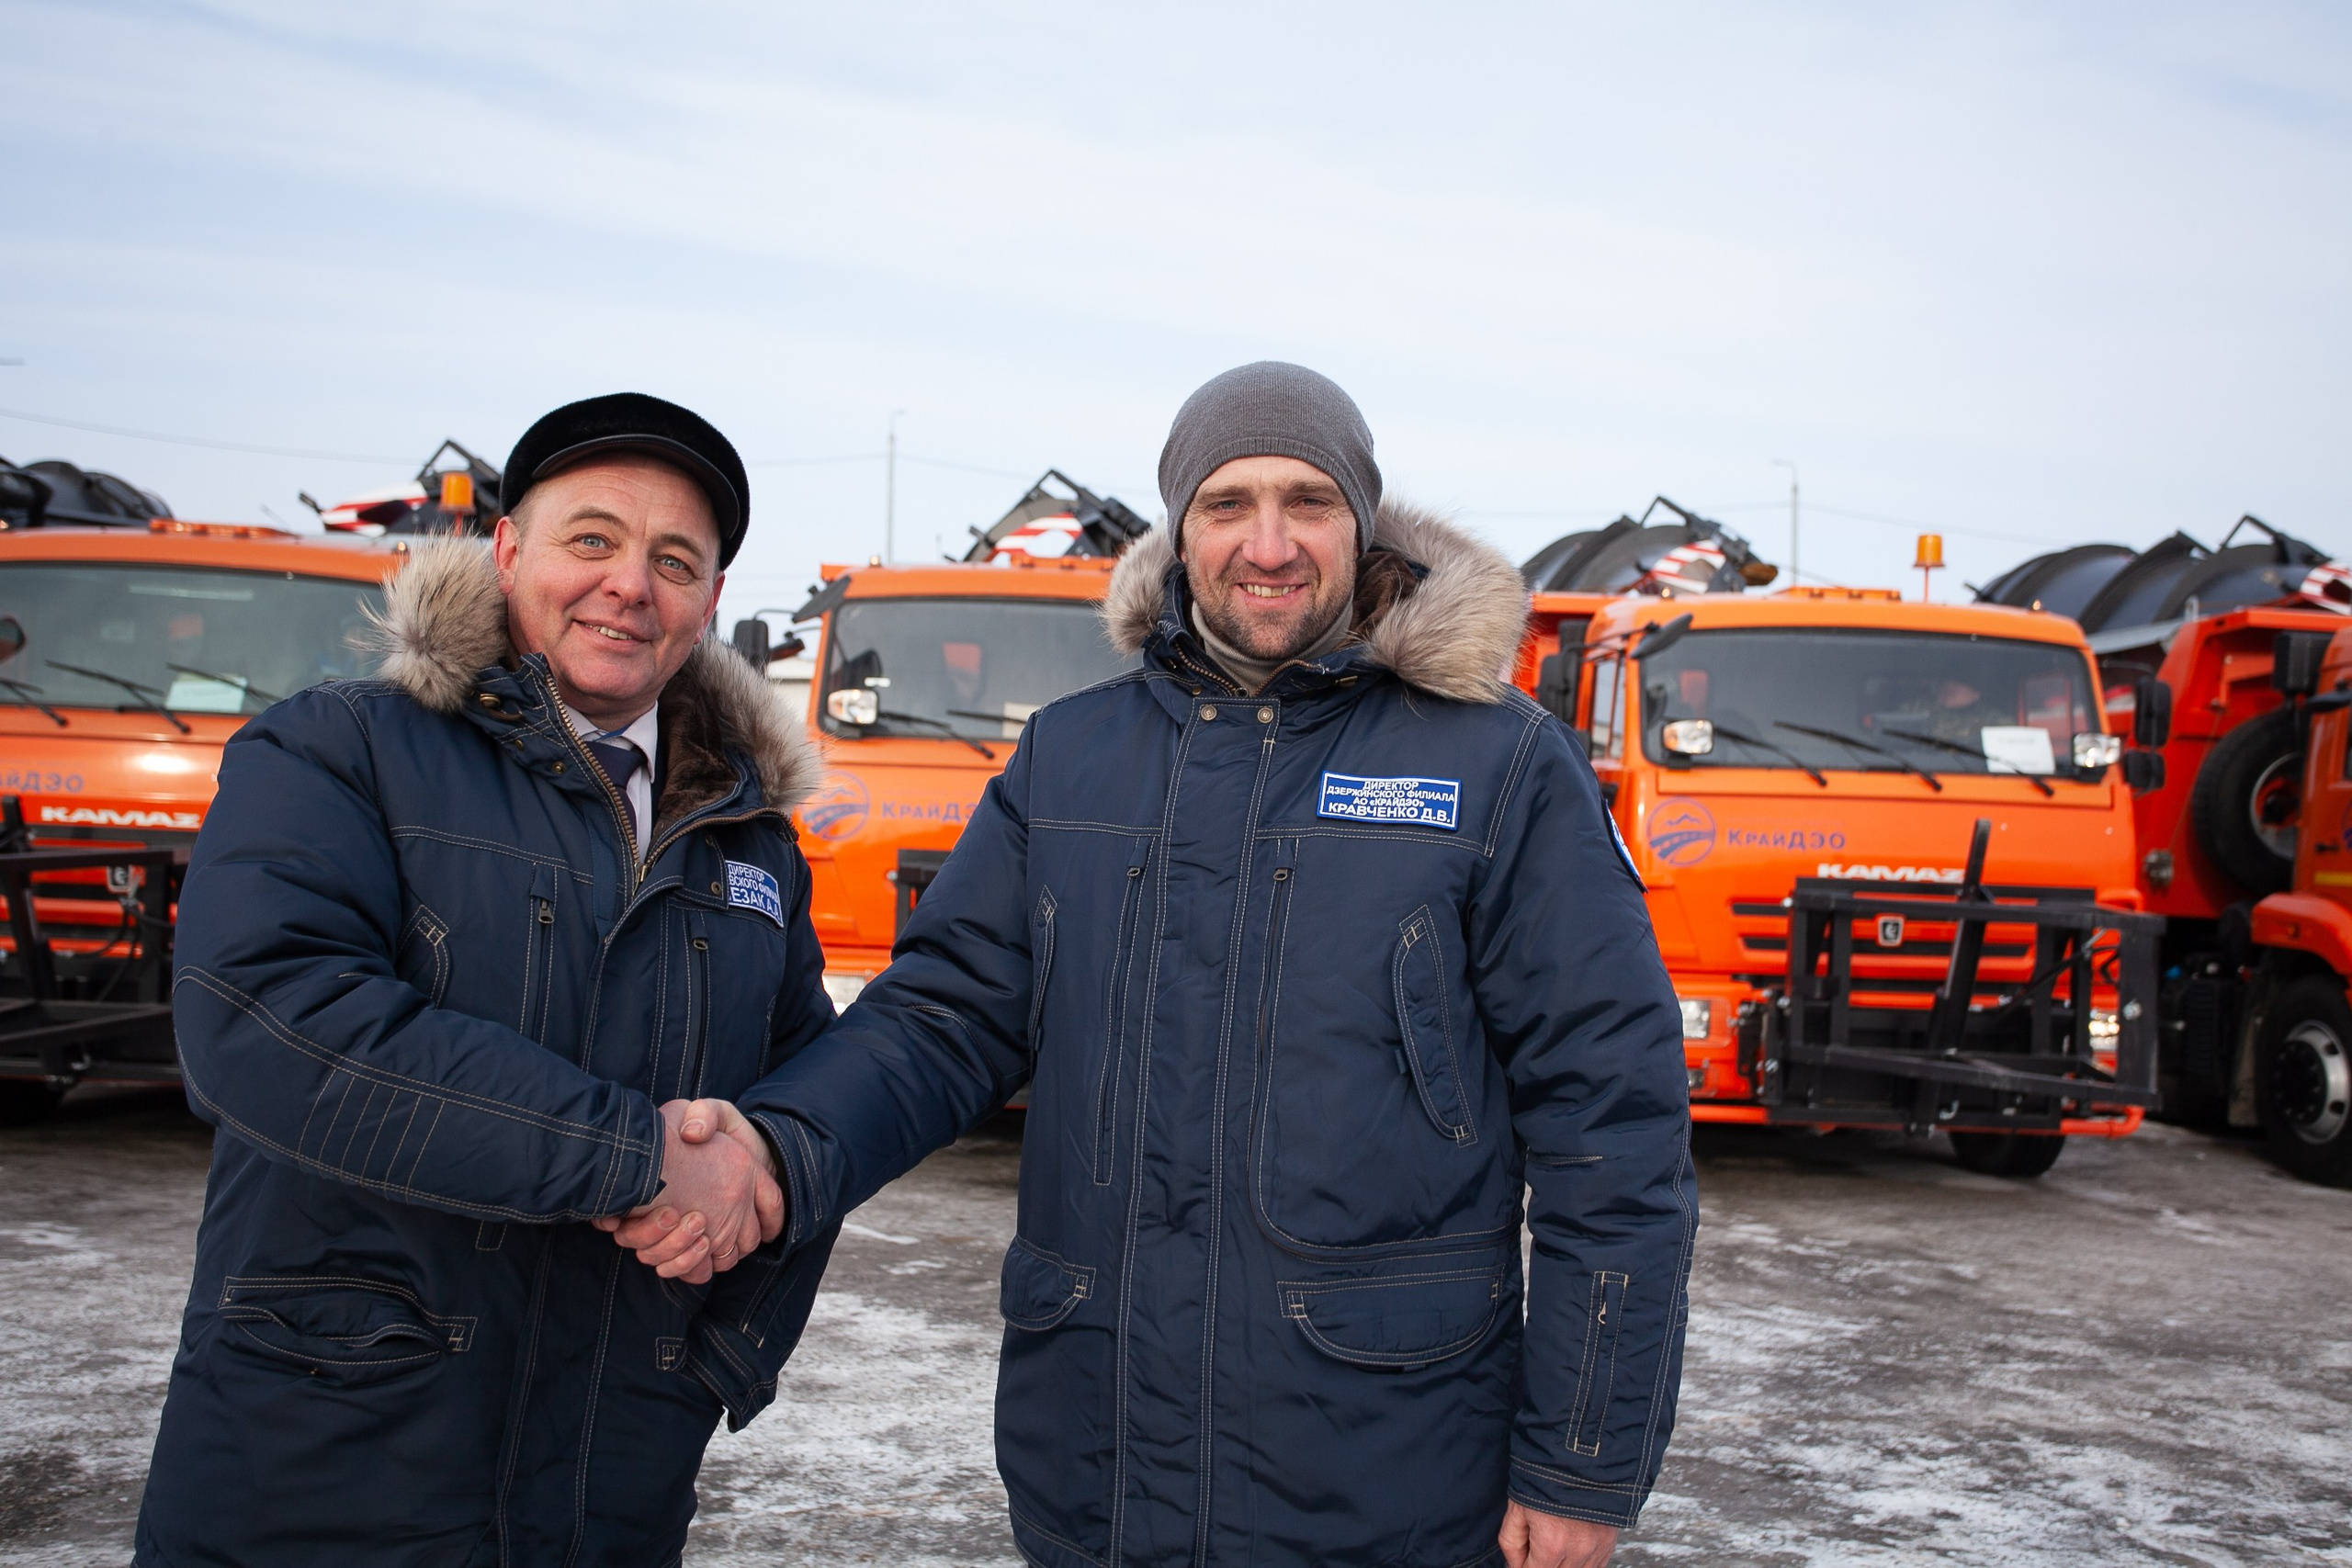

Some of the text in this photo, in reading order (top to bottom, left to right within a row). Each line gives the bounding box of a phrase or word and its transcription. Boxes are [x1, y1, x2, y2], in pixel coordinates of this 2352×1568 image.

[1327, 785, 1454, 802] ДЗЕРЖИНСКОГО ФИЛИАЛА
[1363, 781, 1419, 791] ДИРЕКТОР
[1352, 796, 1425, 807] АО «КРАЙДЭО»
[40, 806, 201, 829] KAMAZ
[1329, 802, 1451, 823] КРАВЧЕНКО Д.В.
[728, 863, 764, 883] ДИРЕКТОР
[1817, 863, 1965, 885] KAMAZ
[729, 886, 766, 910] ЕЗАК
